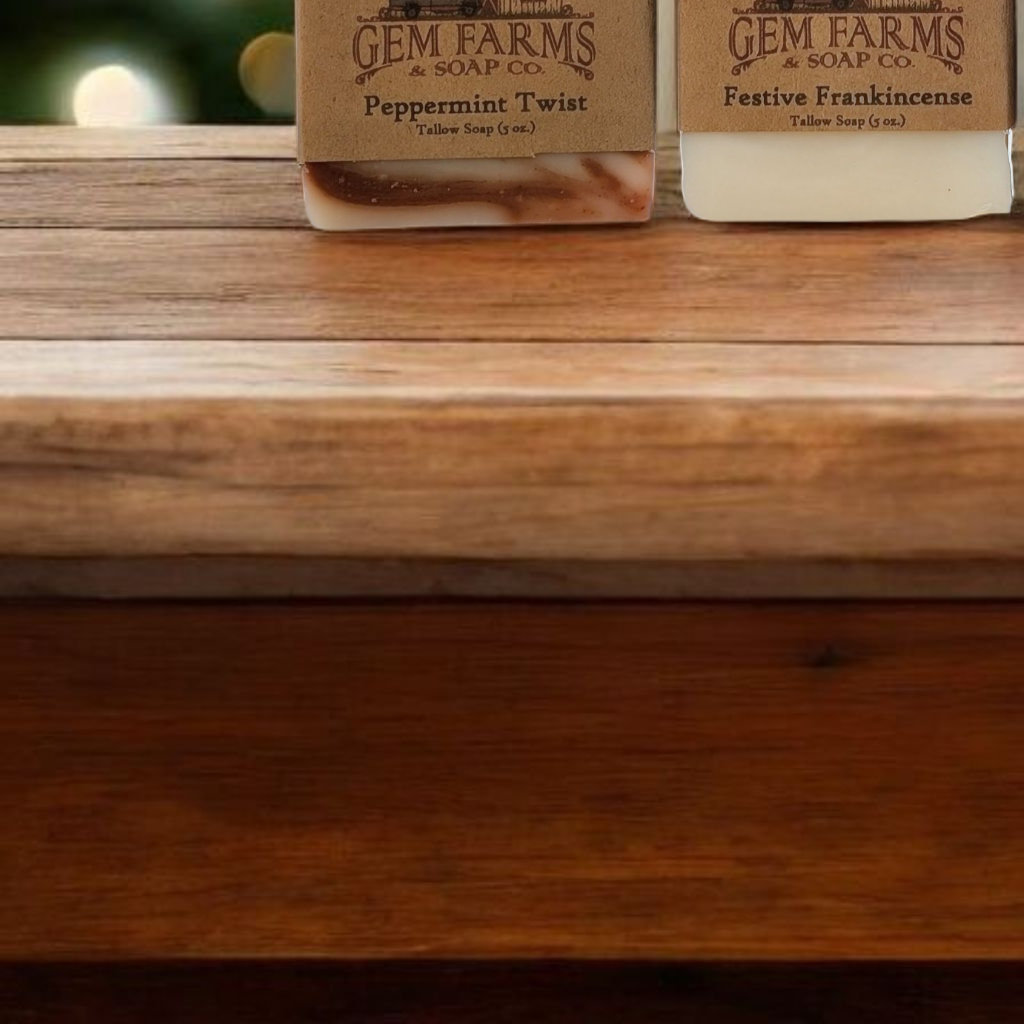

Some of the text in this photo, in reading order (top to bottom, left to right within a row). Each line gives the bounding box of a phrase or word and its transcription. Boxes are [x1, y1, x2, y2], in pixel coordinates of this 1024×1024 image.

[352, 21, 596, 69] GEM FARMS
[729, 16, 965, 61] GEM FARMS
[409, 59, 546, 76] & SOAP CO.
[783, 52, 916, 68] & SOAP CO.
[724, 84, 972, 106] Festive Frankincense
[364, 92, 588, 122] Peppermint Twist
[416, 121, 535, 136] Tallow Soap (5 oz.)
[790, 114, 906, 129] Tallow Soap (5 oz.)
